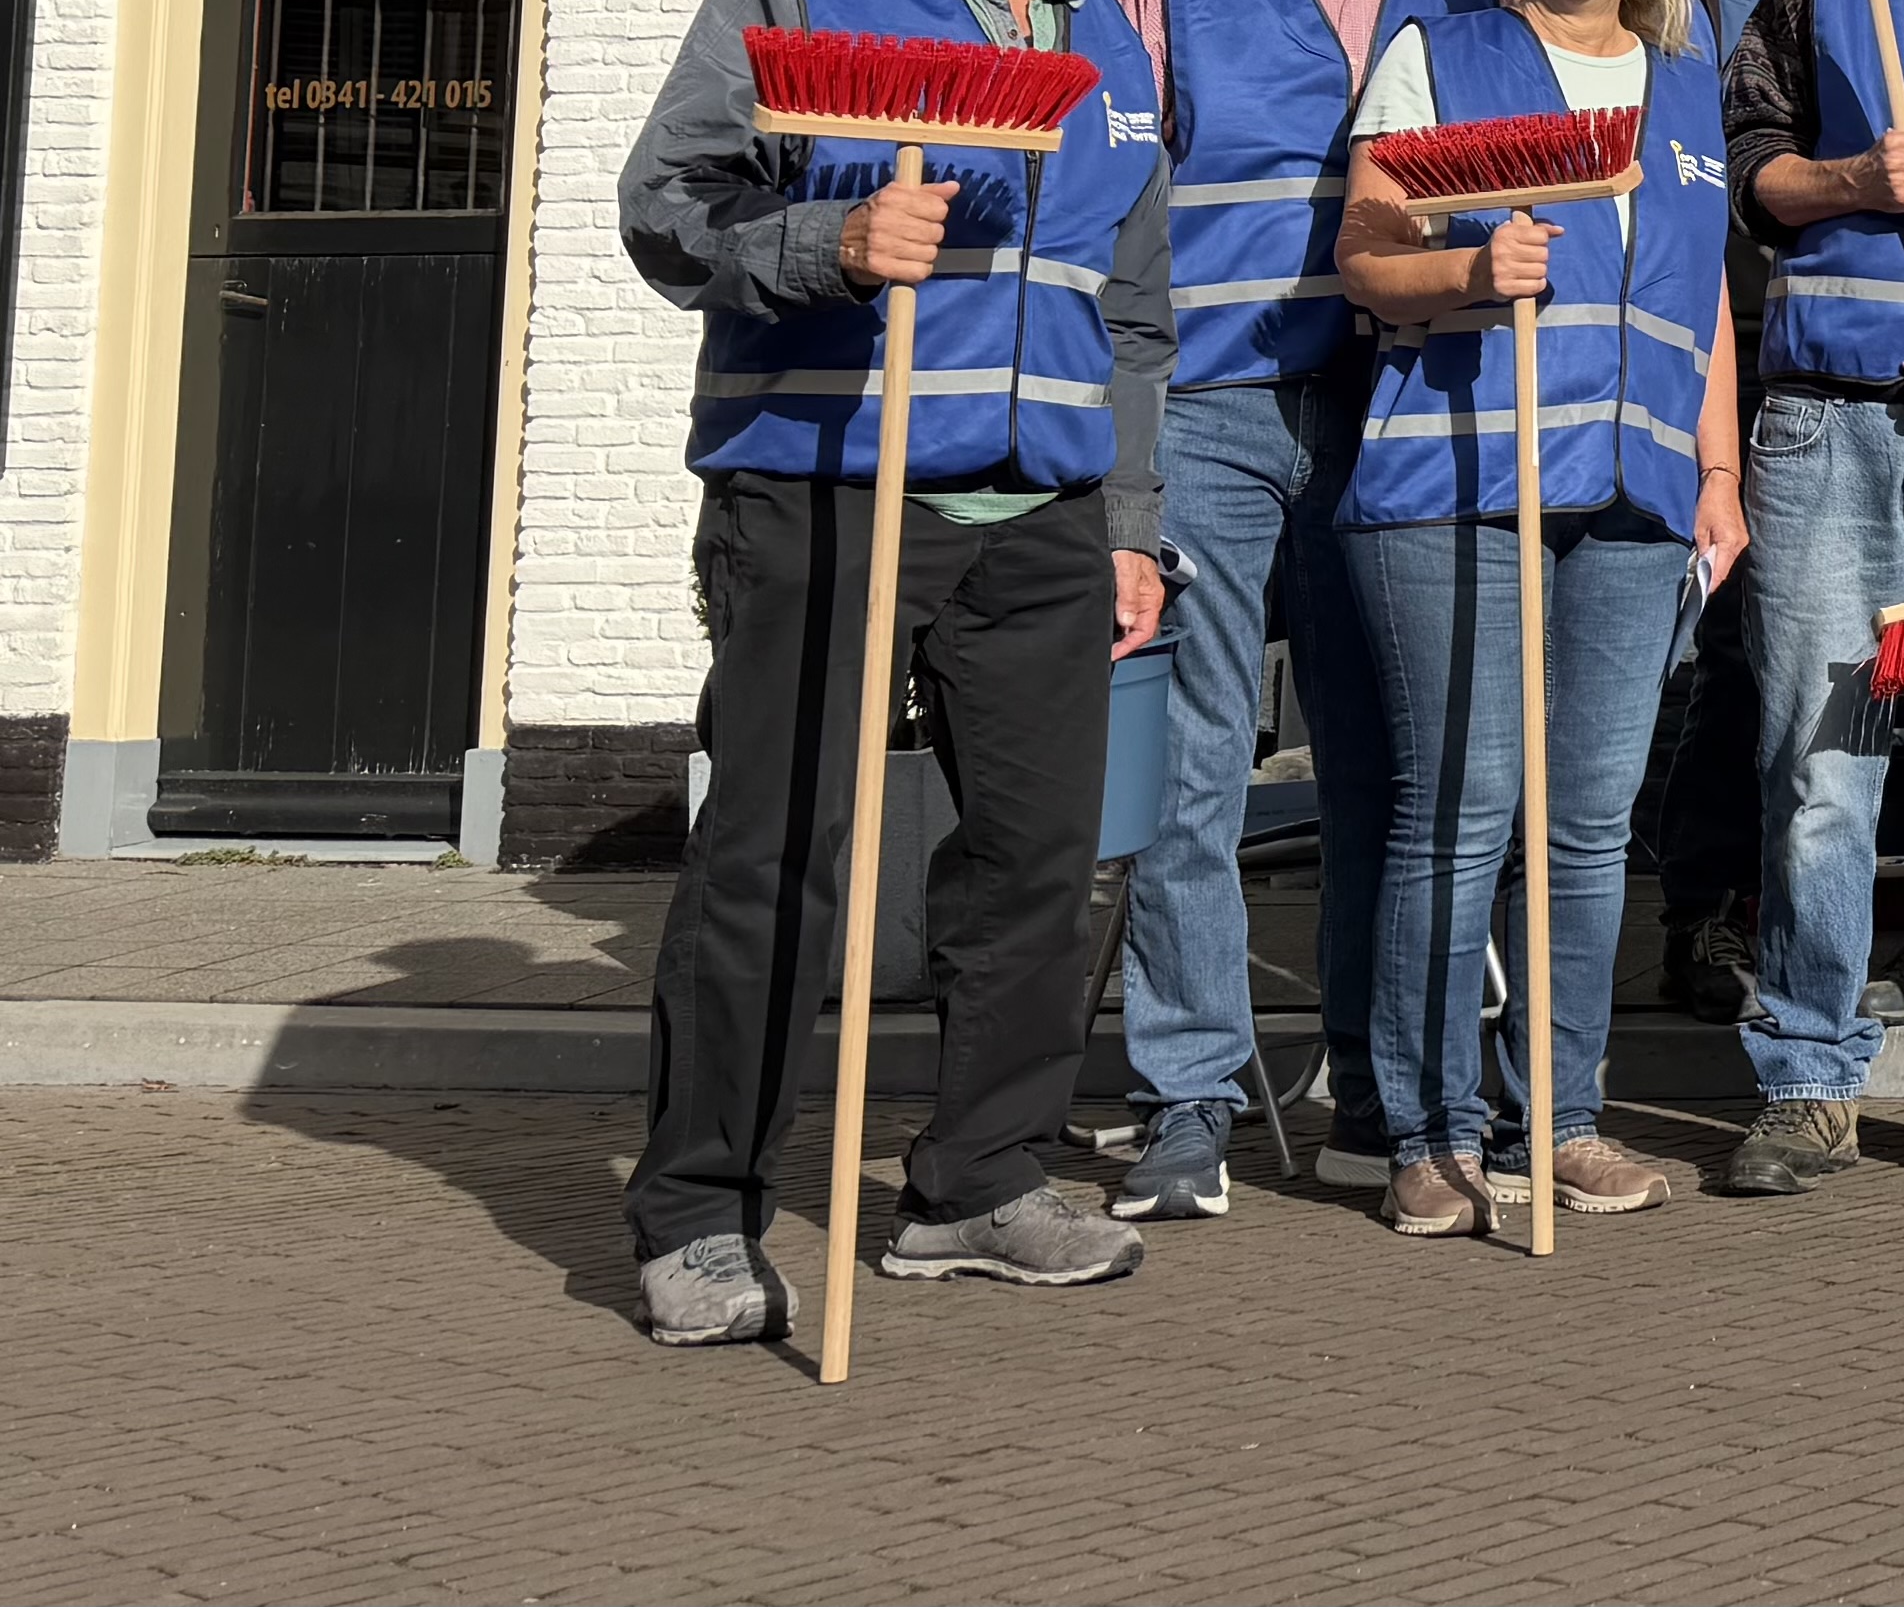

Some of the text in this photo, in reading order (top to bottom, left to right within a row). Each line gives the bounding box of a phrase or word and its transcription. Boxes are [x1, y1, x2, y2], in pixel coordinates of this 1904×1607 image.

[265, 79, 299, 111] tel
[390, 80, 436, 109] 421
[445, 80, 493, 109] 015
